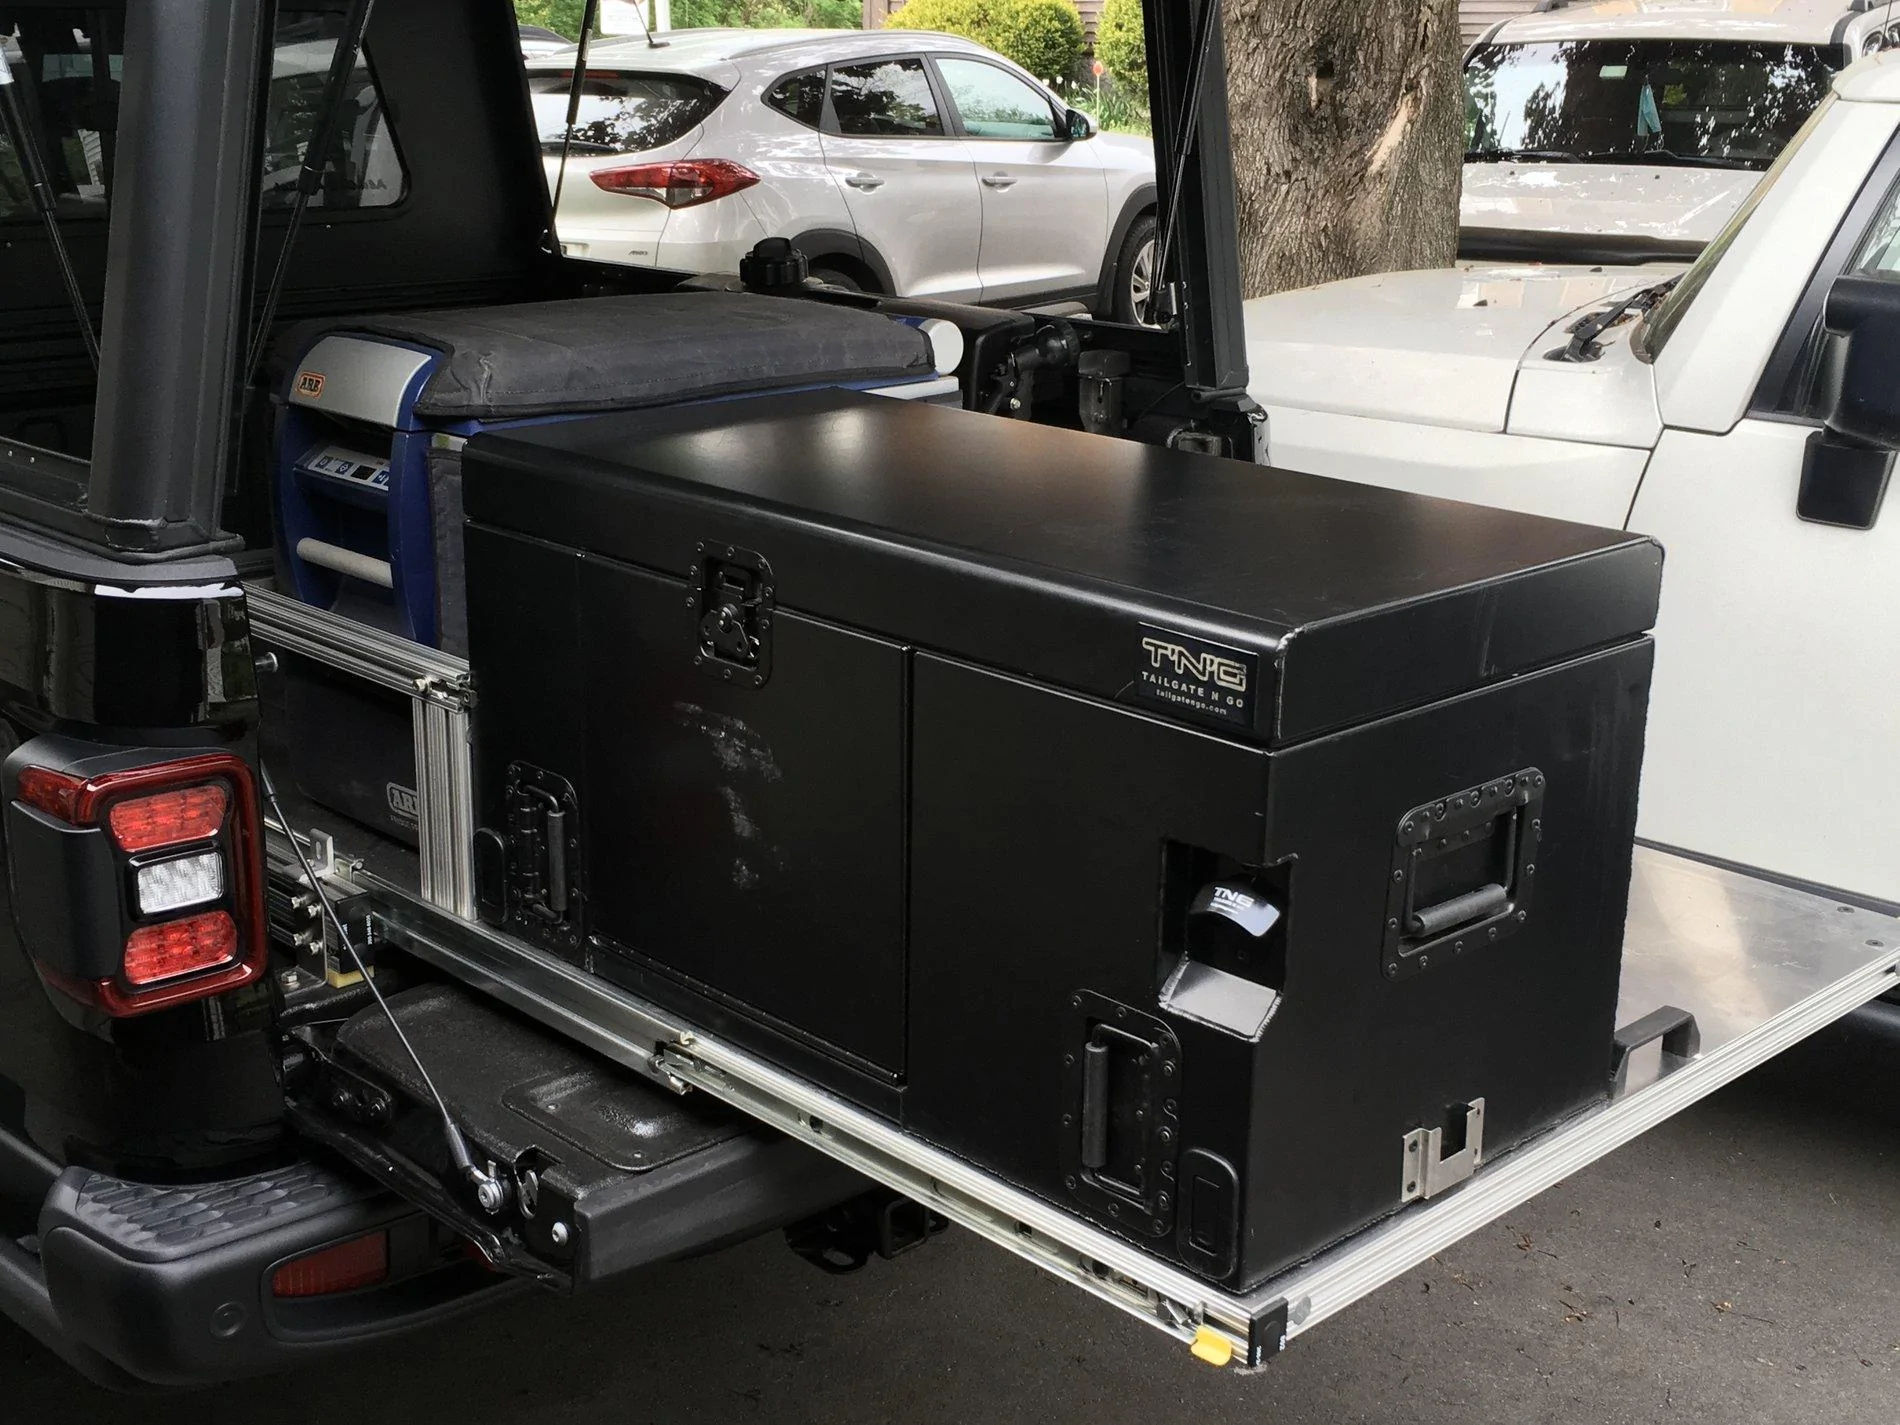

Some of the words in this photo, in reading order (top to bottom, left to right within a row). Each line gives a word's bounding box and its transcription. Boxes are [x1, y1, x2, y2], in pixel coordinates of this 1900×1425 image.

[299, 376, 321, 392] ARB
[1142, 637, 1247, 692] TNG
[1141, 671, 1205, 697] TAILGATE
[1211, 691, 1219, 701] N
[1226, 696, 1244, 708] GO
[1156, 689, 1227, 715] tailgatengo.com
[1214, 886, 1255, 908] TNG
